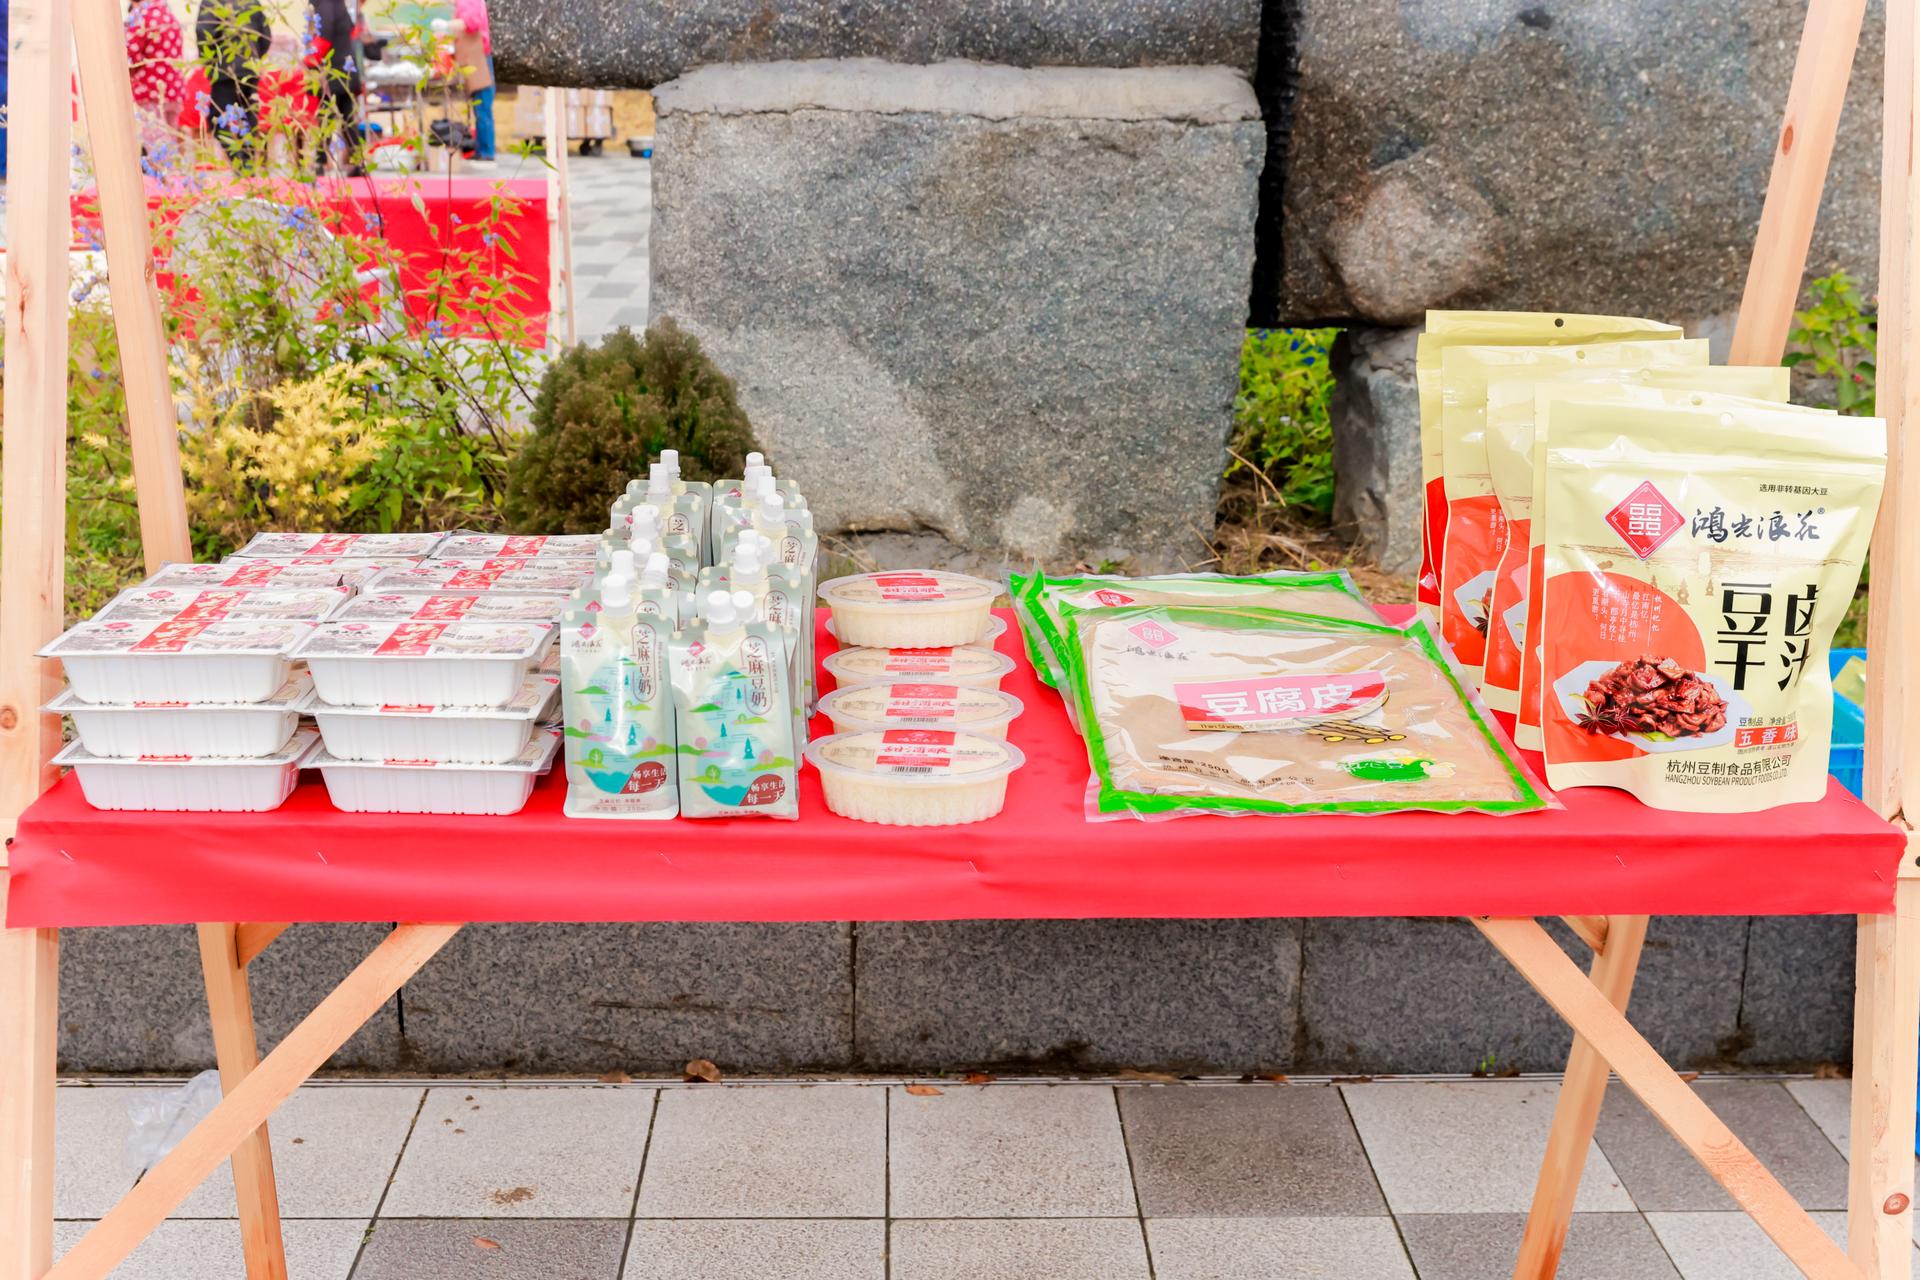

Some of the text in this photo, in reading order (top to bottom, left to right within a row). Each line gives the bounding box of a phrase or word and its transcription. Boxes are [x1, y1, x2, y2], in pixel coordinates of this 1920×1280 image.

[1759, 483, 1828, 496] 选用非转基因大豆
[1692, 507, 1820, 543] 鸿光浪花
[1714, 583, 1772, 691] 豆干
[636, 628, 652, 695] 芝麻豆奶
[747, 642, 767, 708] 芝麻豆奶
[1201, 682, 1361, 717] 豆腐皮
[1738, 724, 1797, 747] 五香味
[1665, 774, 1700, 785] HANGZHOU
[1701, 776, 1730, 786] SOYBEAN
[1731, 775, 1758, 786] PRODUCT
[1666, 754, 1792, 776] 杭州豆制食品有限公司
